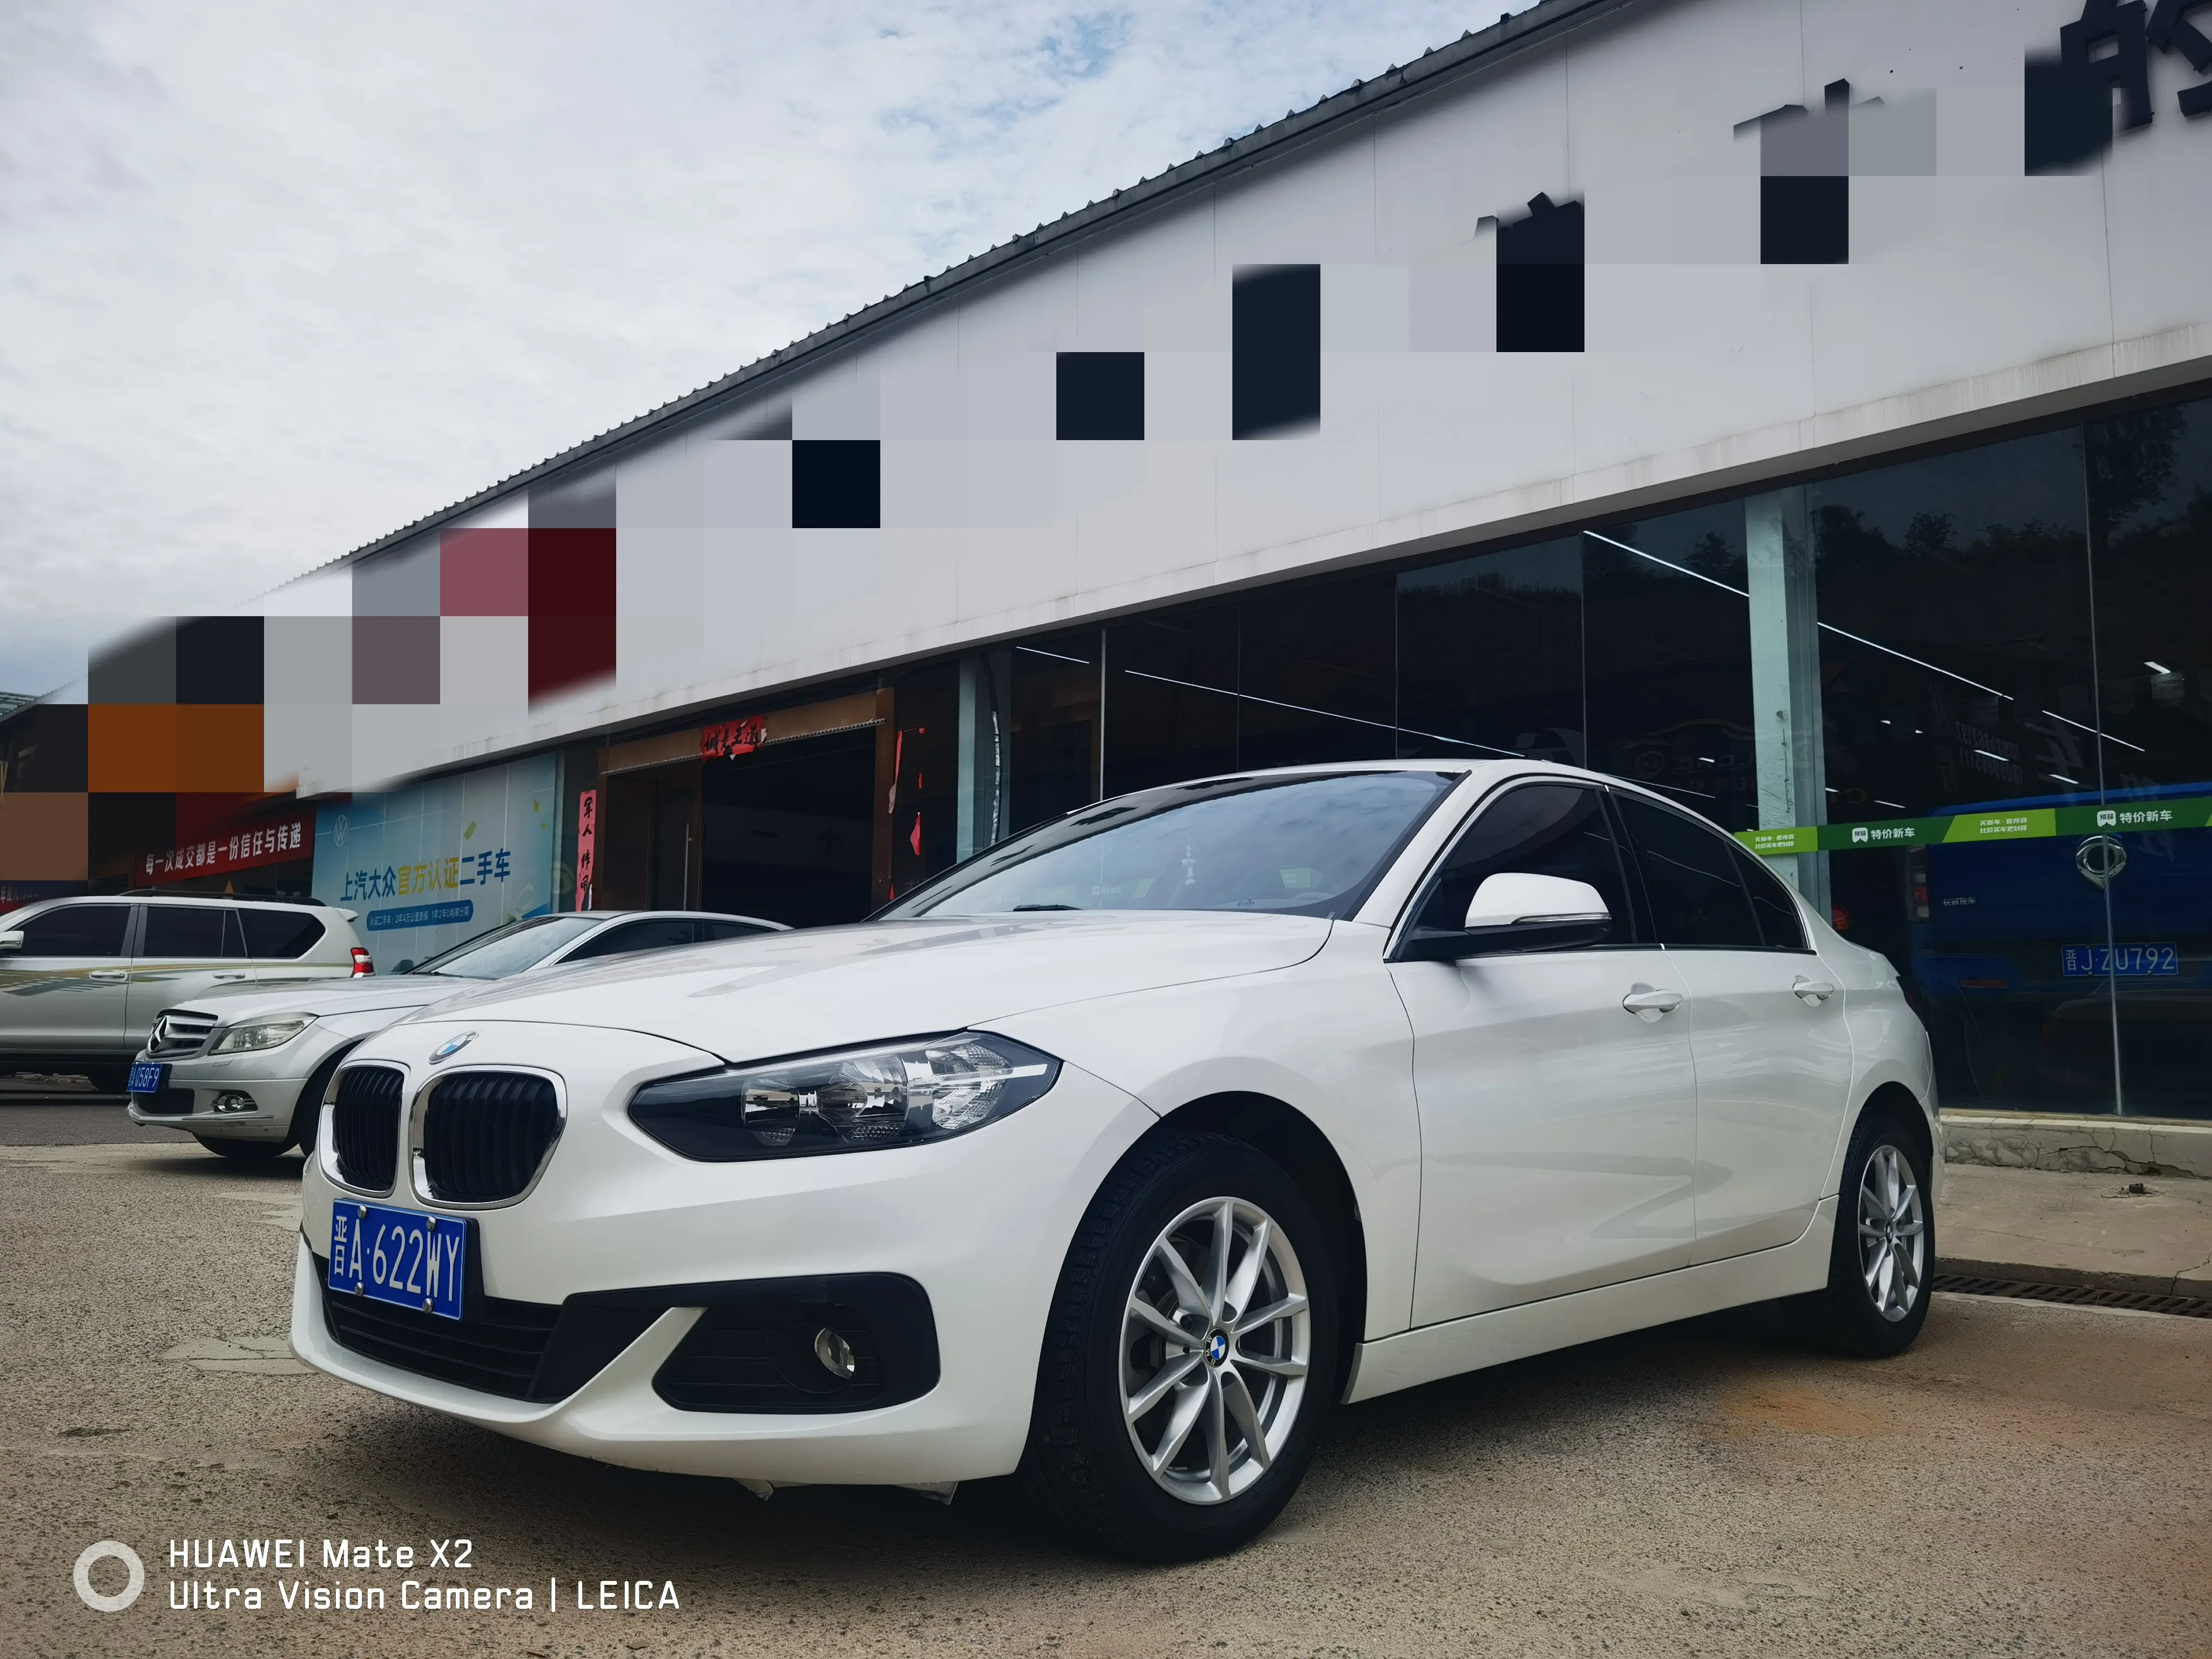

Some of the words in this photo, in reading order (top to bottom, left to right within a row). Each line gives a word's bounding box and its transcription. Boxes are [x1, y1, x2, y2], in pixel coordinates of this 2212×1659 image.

[1870, 827, 1915, 840] 特价新车
[2119, 810, 2173, 824] 特价新车
[145, 822, 301, 875] 每一次成交都是一份信任与传递
[340, 848, 511, 901] 上汽大众官方认证二手车
